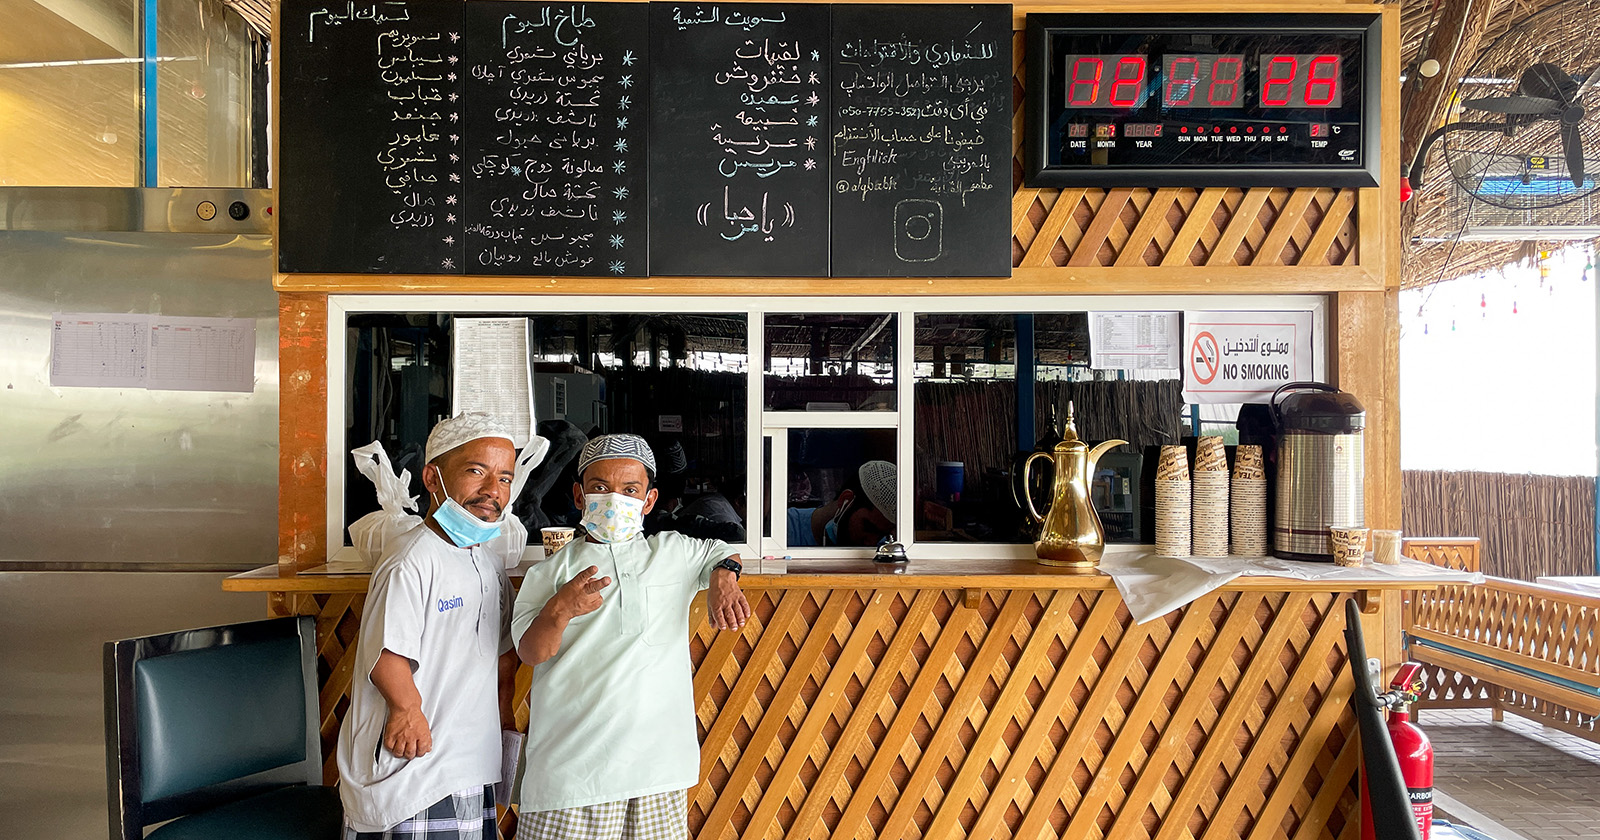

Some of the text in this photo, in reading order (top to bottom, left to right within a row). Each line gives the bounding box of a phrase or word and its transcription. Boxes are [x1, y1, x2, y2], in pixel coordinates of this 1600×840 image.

[307, 1, 354, 42] اليوم
[502, 6, 550, 49] اليوم
[1262, 56, 1340, 106] 26
[1260, 338, 1289, 356] ممنوع
[1223, 364, 1290, 380] NO SMOKING
[552, 532, 565, 540] TEA
[1335, 531, 1348, 539] TEA
[438, 595, 463, 612] Qasim
